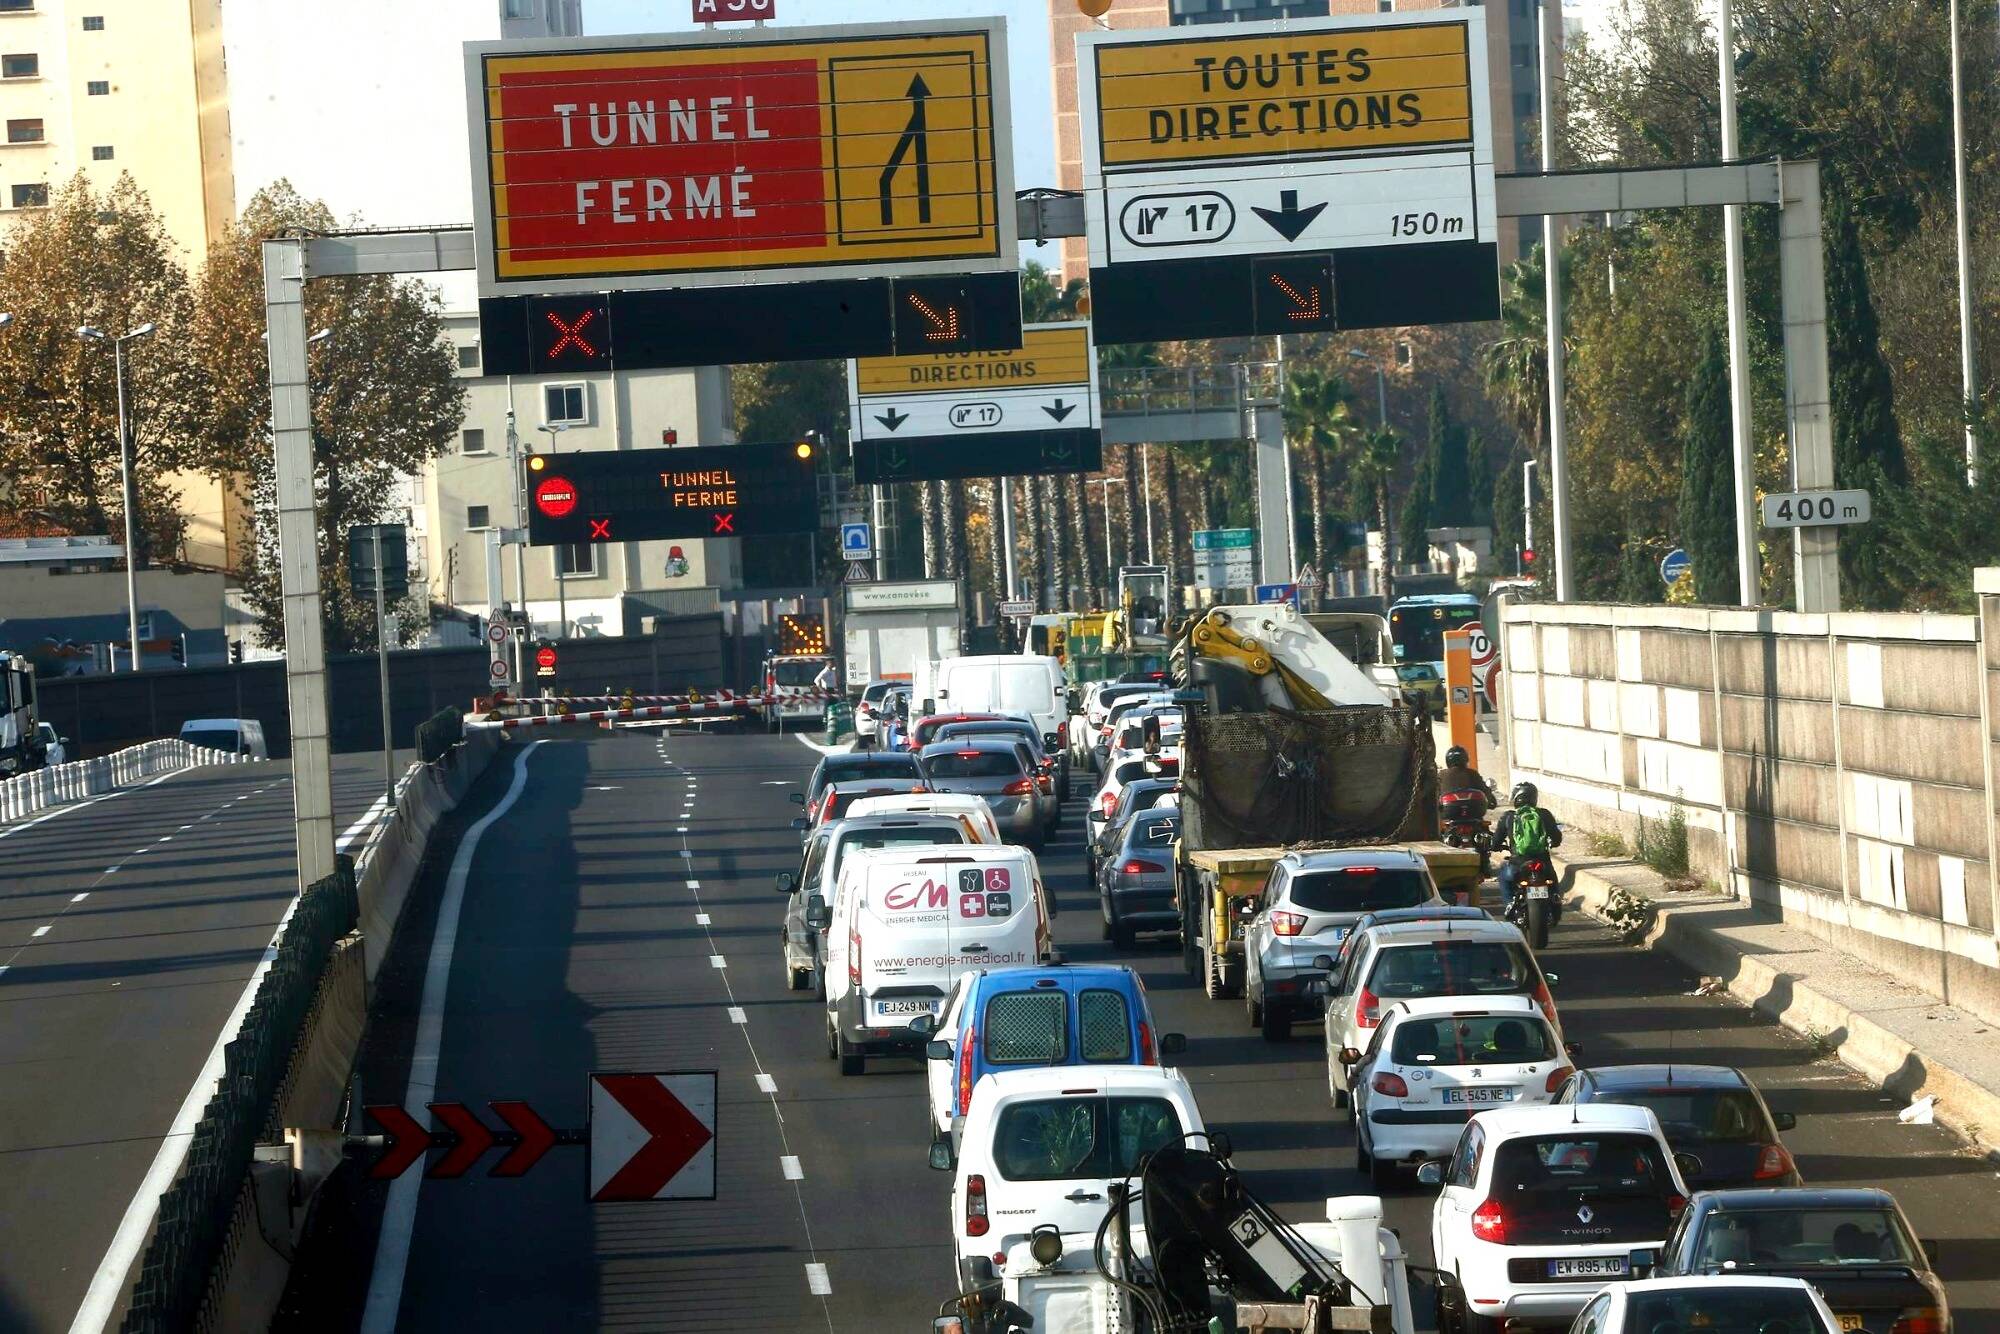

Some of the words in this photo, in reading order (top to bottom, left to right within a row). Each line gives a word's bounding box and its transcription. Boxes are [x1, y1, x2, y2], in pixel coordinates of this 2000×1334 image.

[1194, 47, 1372, 93] TOUTES
[553, 95, 770, 149] TUNNEL
[1149, 93, 1422, 145] DIRECTIONS
[576, 165, 757, 226] FERMÉ
[1184, 203, 1219, 232] 17
[910, 361, 1037, 384] DIRECTIONS
[979, 407, 995, 422] 17
[660, 470, 736, 488] TUNNEL
[674, 490, 737, 507] FERME
[1776, 497, 1836, 522] 400
[1843, 505, 1858, 518] m
[1433, 608, 1443, 620] 9
[884, 878, 949, 910] EM
[873, 951, 1026, 969] www.energie-medical.fr
[1561, 1227, 1613, 1235] TWINGO
